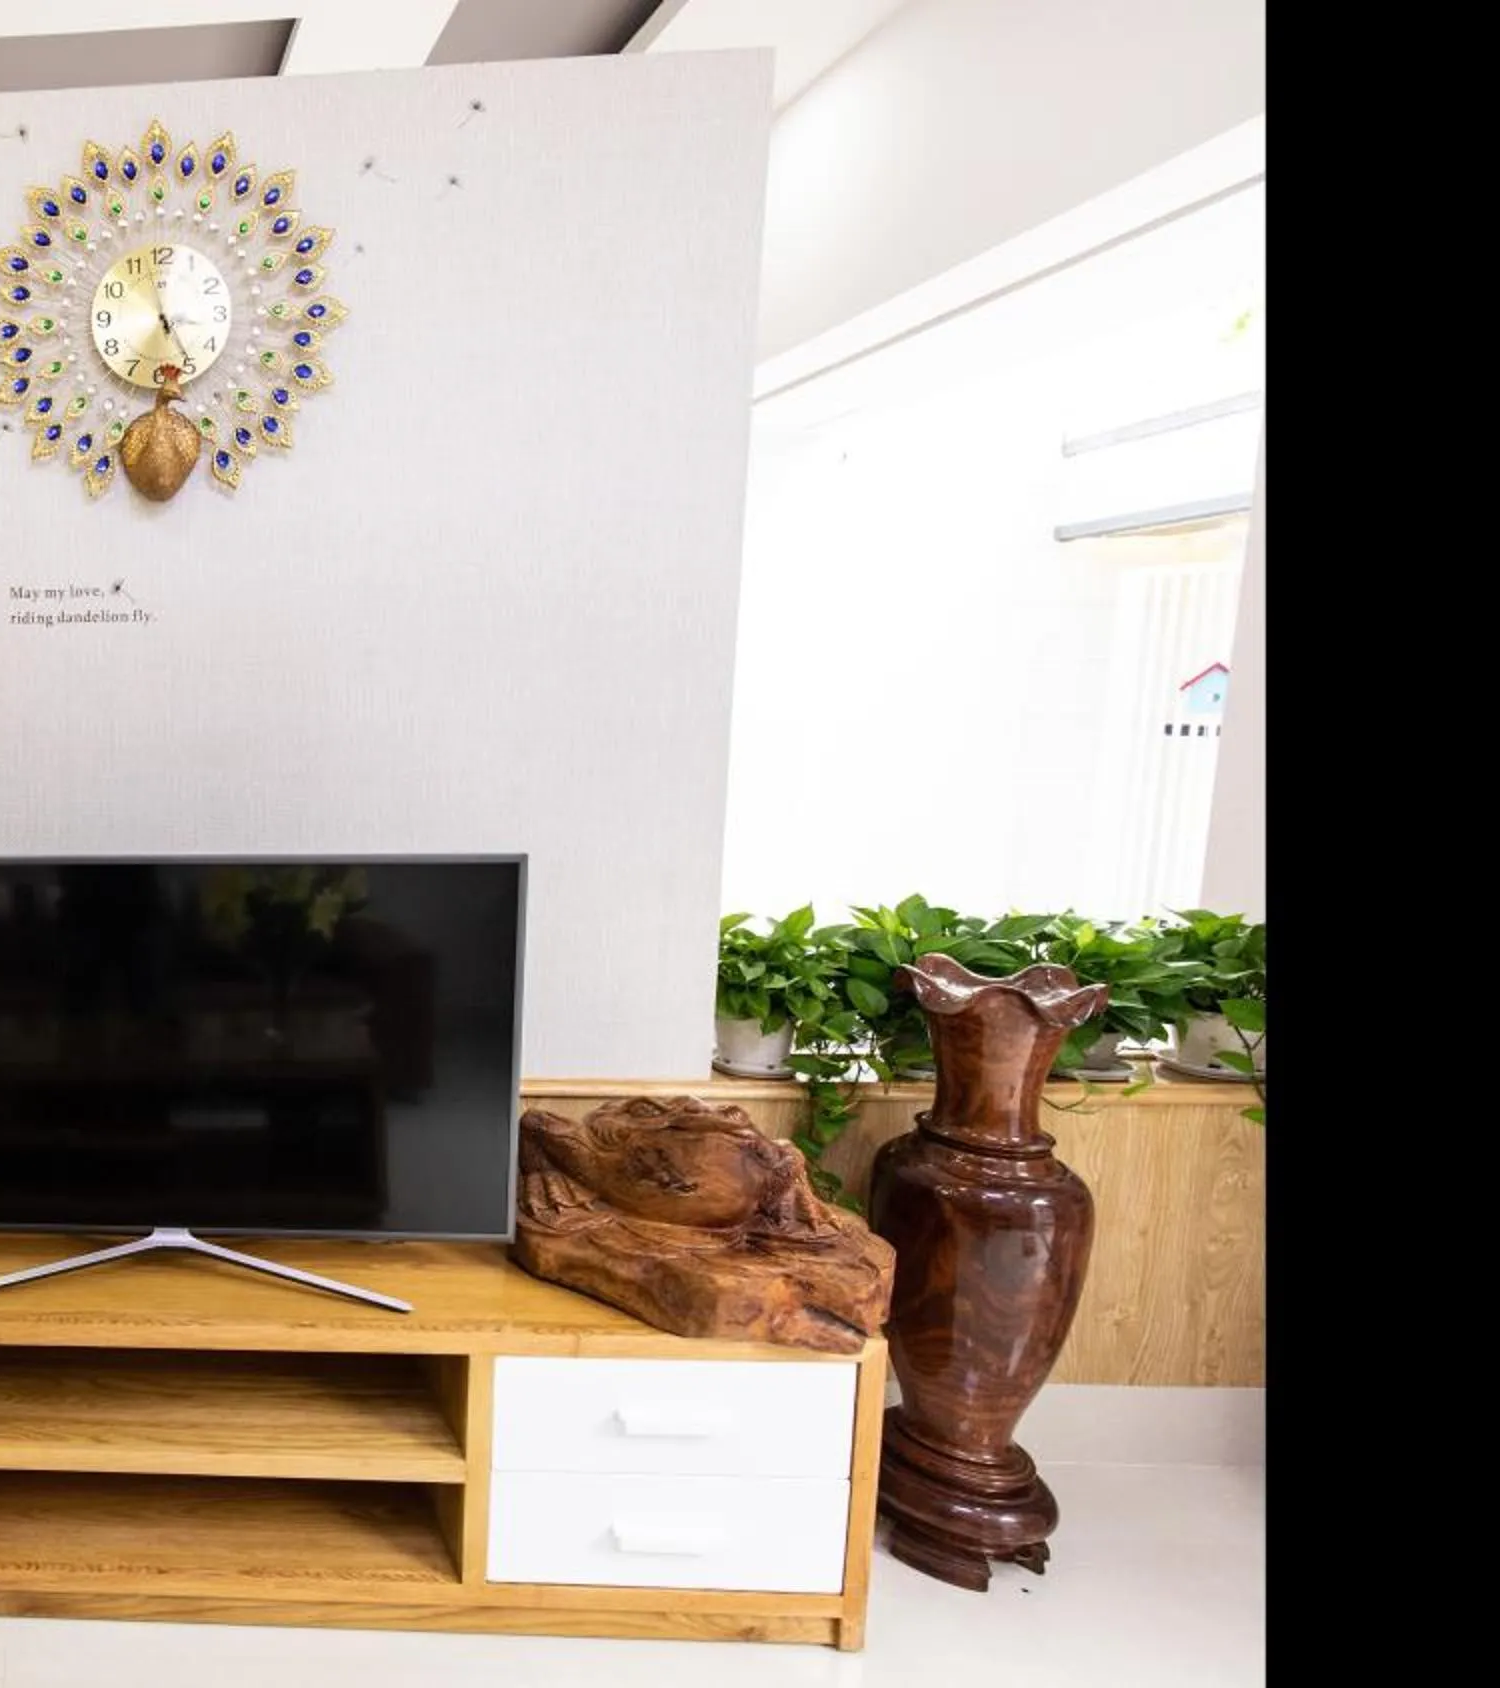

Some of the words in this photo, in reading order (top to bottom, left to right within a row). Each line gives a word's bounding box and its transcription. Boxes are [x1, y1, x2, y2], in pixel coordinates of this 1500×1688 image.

[150, 247, 174, 265] 12
[187, 255, 195, 272] 1
[125, 257, 142, 275] 11
[103, 281, 124, 299] 10
[203, 277, 221, 295] 2
[96, 309, 112, 329] 9
[213, 305, 227, 323] 3
[104, 338, 120, 356] 8
[203, 336, 217, 352] 4
[124, 359, 141, 377] 7
[182, 357, 197, 375] 5
[9, 586, 39, 601] May
[44, 588, 64, 603] my
[69, 585, 105, 599] love,
[9, 611, 54, 628] riding
[57, 609, 129, 624] dandelion
[132, 609, 158, 625] fly.
